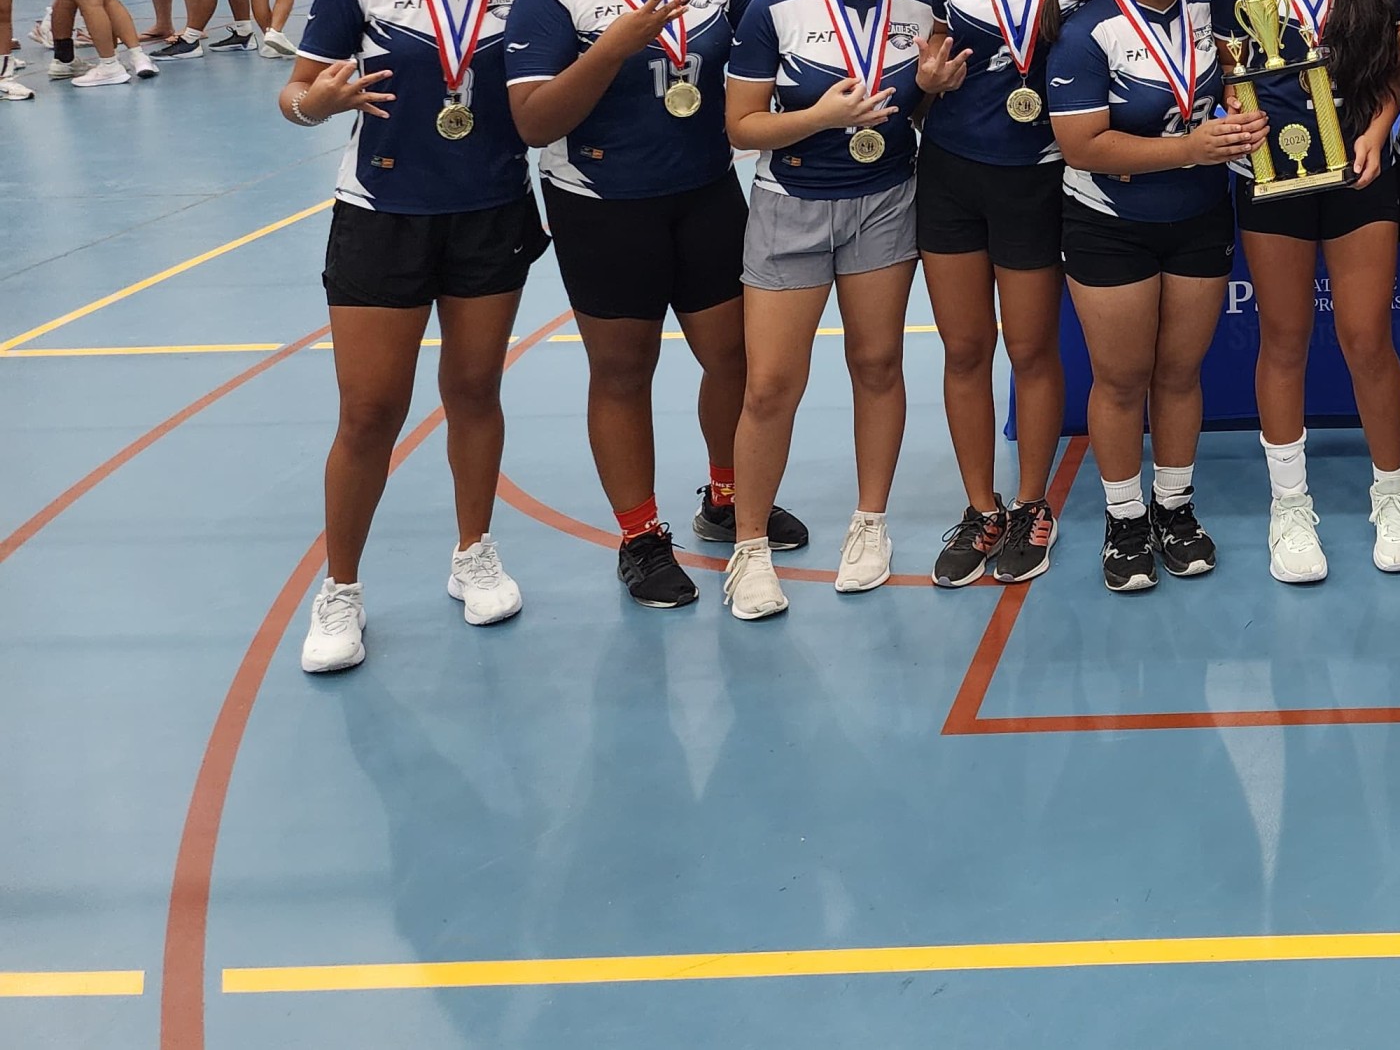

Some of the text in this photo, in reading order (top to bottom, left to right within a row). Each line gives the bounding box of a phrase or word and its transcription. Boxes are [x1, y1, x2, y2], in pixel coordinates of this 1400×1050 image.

[594, 4, 624, 19] FAT
[806, 30, 837, 44] FAT
[648, 51, 704, 99] 19
[1284, 135, 1307, 147] 2024
